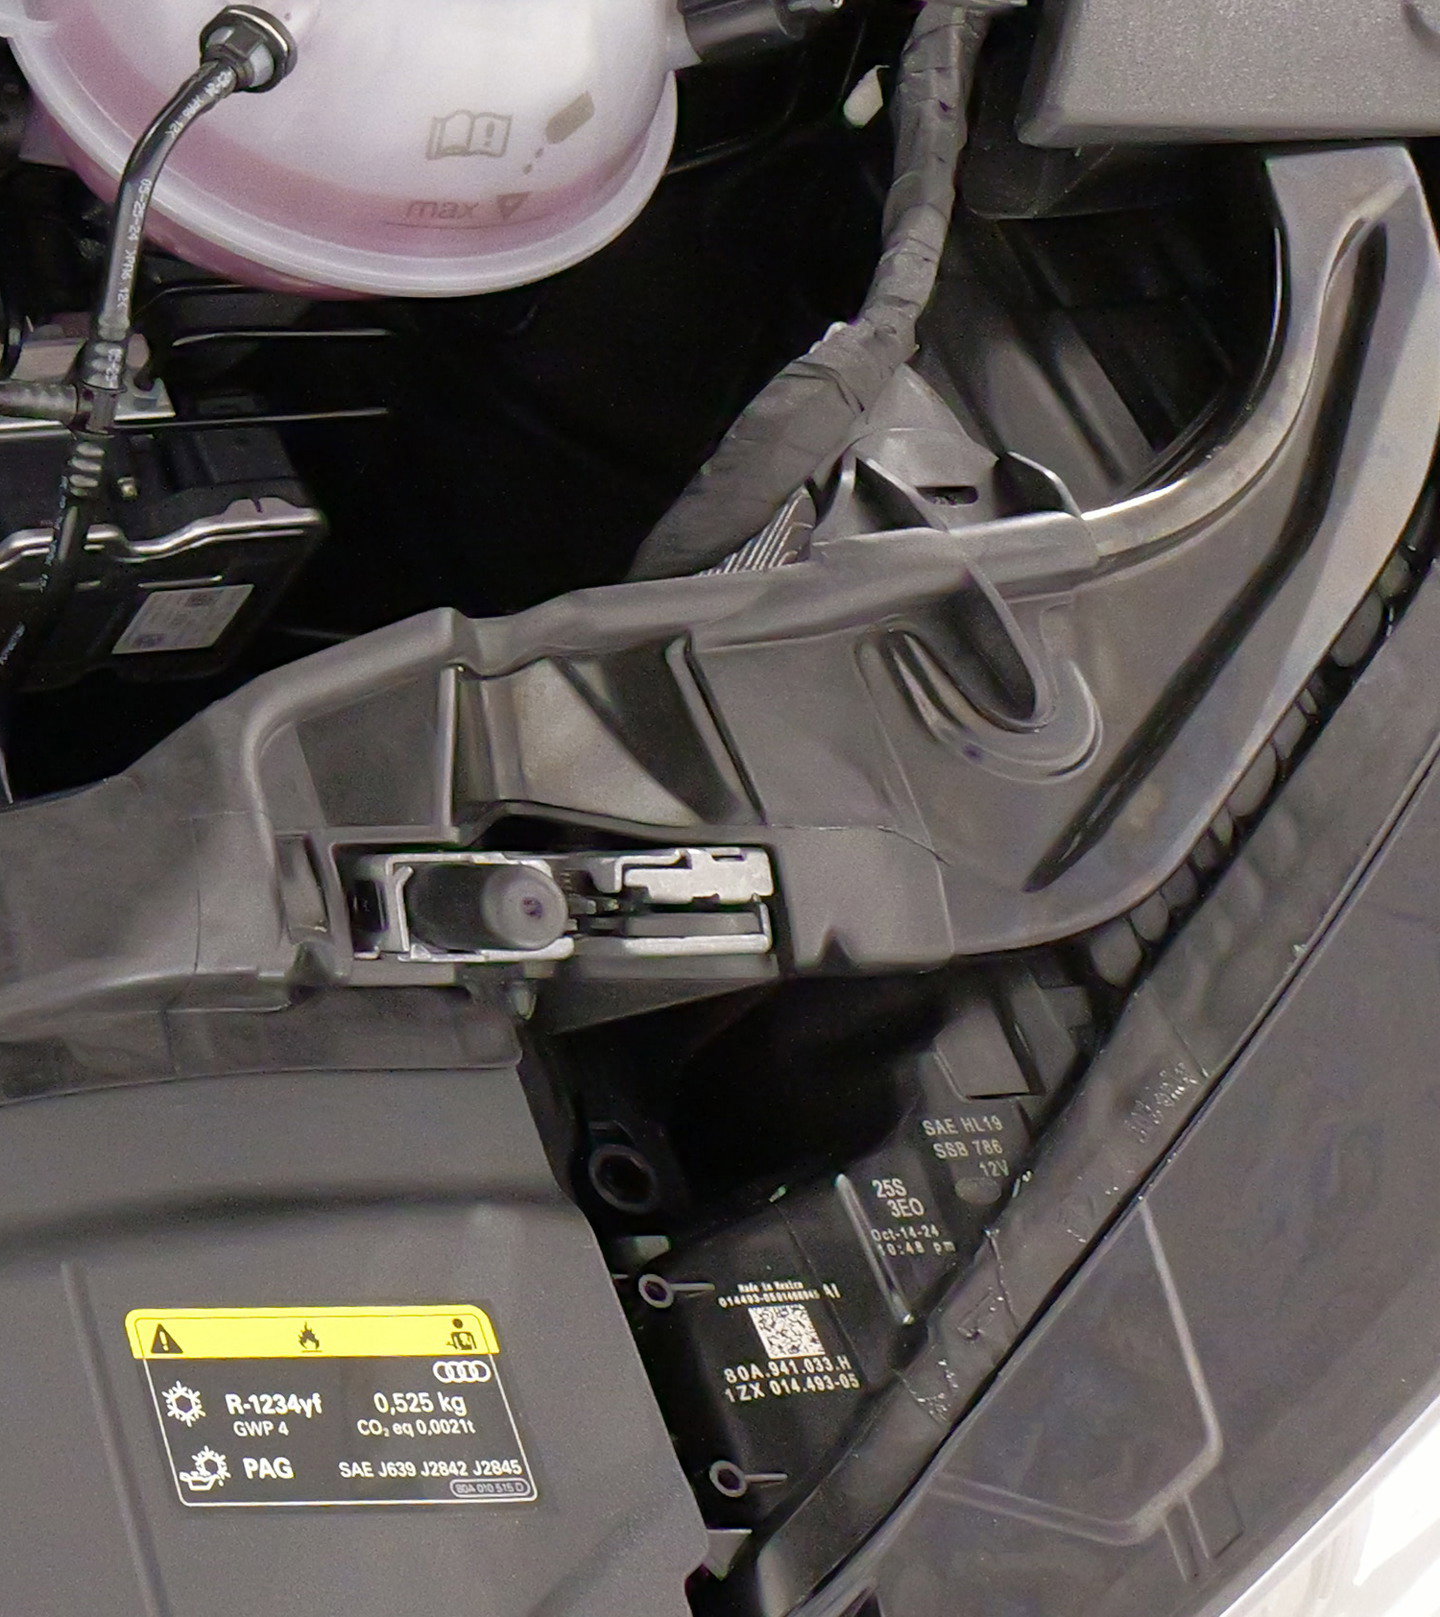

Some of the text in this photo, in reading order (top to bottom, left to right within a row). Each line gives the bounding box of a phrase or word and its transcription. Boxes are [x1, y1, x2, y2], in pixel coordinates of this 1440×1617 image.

[405, 194, 479, 221] max
[922, 1119, 958, 1135] SAE
[933, 1139, 1003, 1158] SSB 786
[979, 1159, 1009, 1177] 12V
[872, 1178, 907, 1198] 25S
[870, 1224, 939, 1241] Oct-14-24
[724, 1355, 852, 1383] 80A.941.033.H
[725, 1373, 860, 1402] 1ZX 014.493-05
[225, 1392, 467, 1418] R-1234yf 0,525 kg
[233, 1421, 289, 1437] GWP 4
[392, 1422, 414, 1438] eq
[416, 1418, 476, 1436] 0,0021t
[242, 1457, 295, 1479] PAG
[338, 1459, 522, 1478] SAE J639 J2842 J2845
